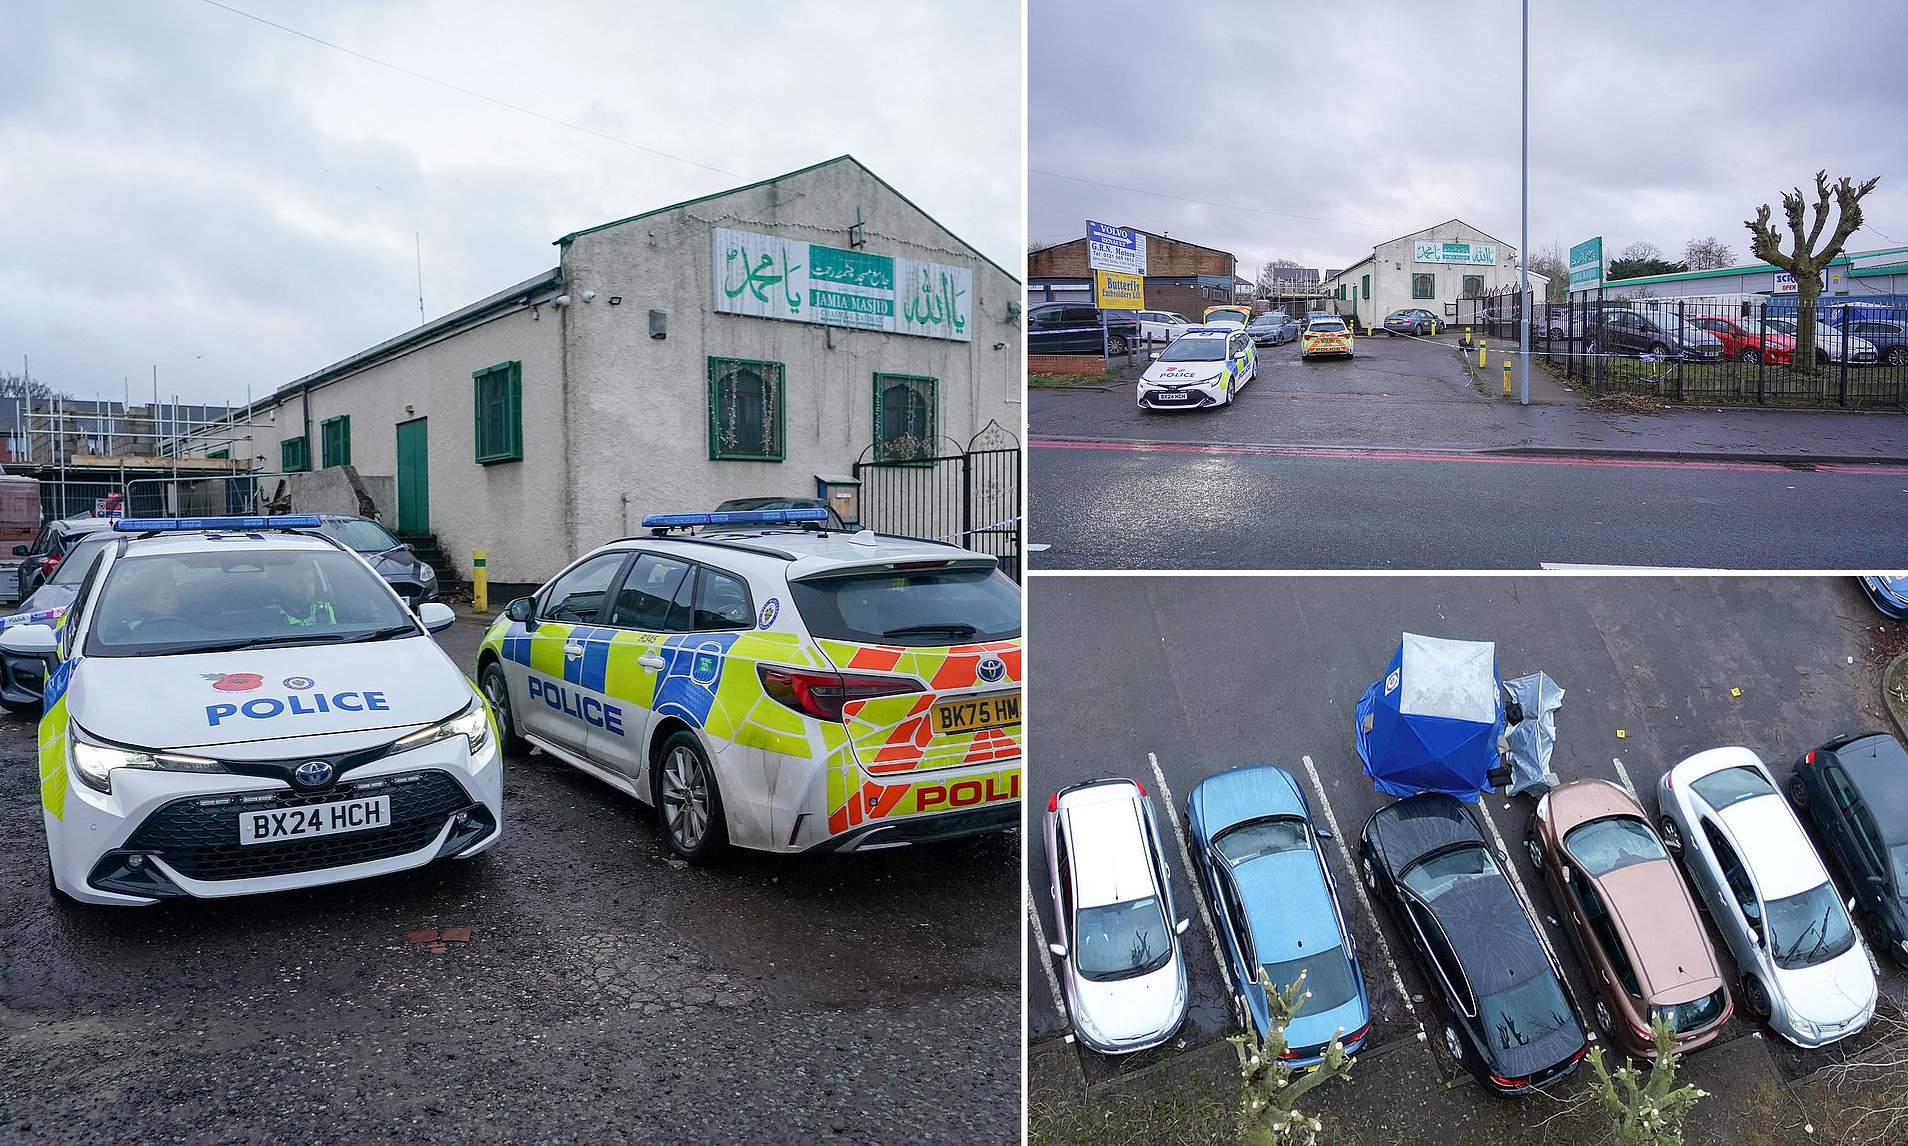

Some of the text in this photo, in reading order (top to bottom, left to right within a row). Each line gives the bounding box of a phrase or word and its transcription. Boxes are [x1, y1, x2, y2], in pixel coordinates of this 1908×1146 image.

[1100, 224, 1128, 239] VOLVO
[1115, 247, 1135, 258] Motors
[1102, 288, 1132, 299] Embroidery
[1107, 277, 1140, 292] Butterfly
[814, 291, 888, 314] JAMIA MASJID
[205, 691, 390, 727] POLICE
[527, 674, 625, 737] POLICE
[940, 697, 1021, 730] BK75 HM
[916, 774, 1019, 812] POLI
[253, 800, 381, 839] BX24 HCH
